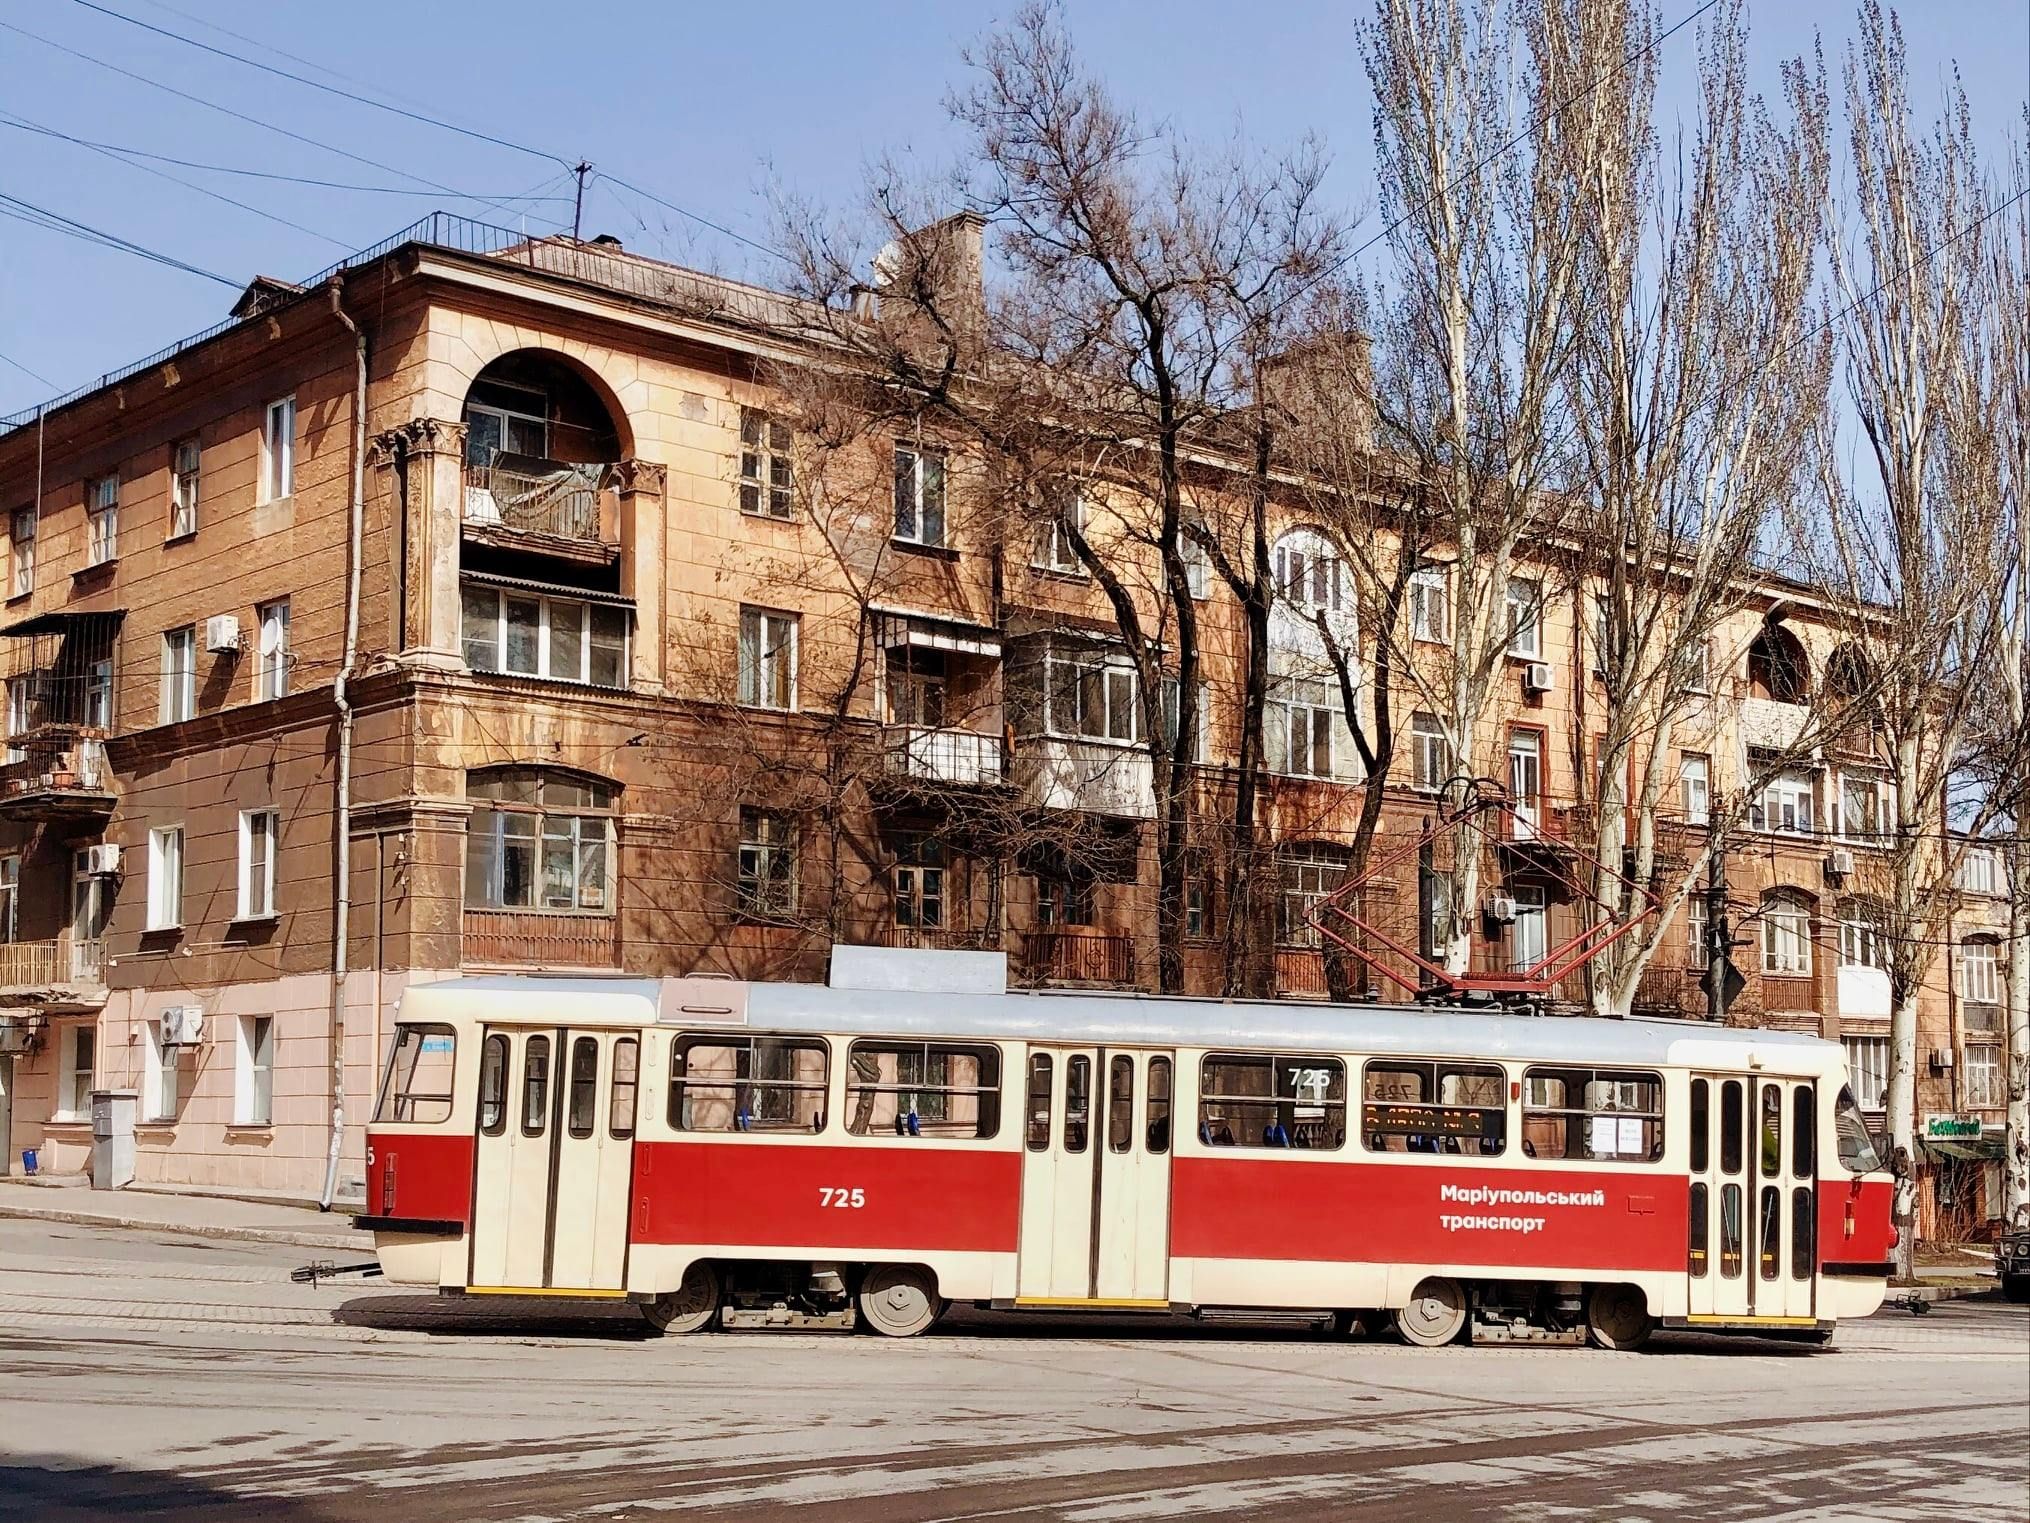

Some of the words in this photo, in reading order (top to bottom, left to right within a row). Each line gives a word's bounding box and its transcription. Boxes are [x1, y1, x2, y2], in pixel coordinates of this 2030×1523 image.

[1288, 1068, 1330, 1087] 725
[818, 1187, 866, 1208] 725
[1440, 1184, 1605, 1206] Маріупольський
[1439, 1215, 1546, 1234] транспорт
